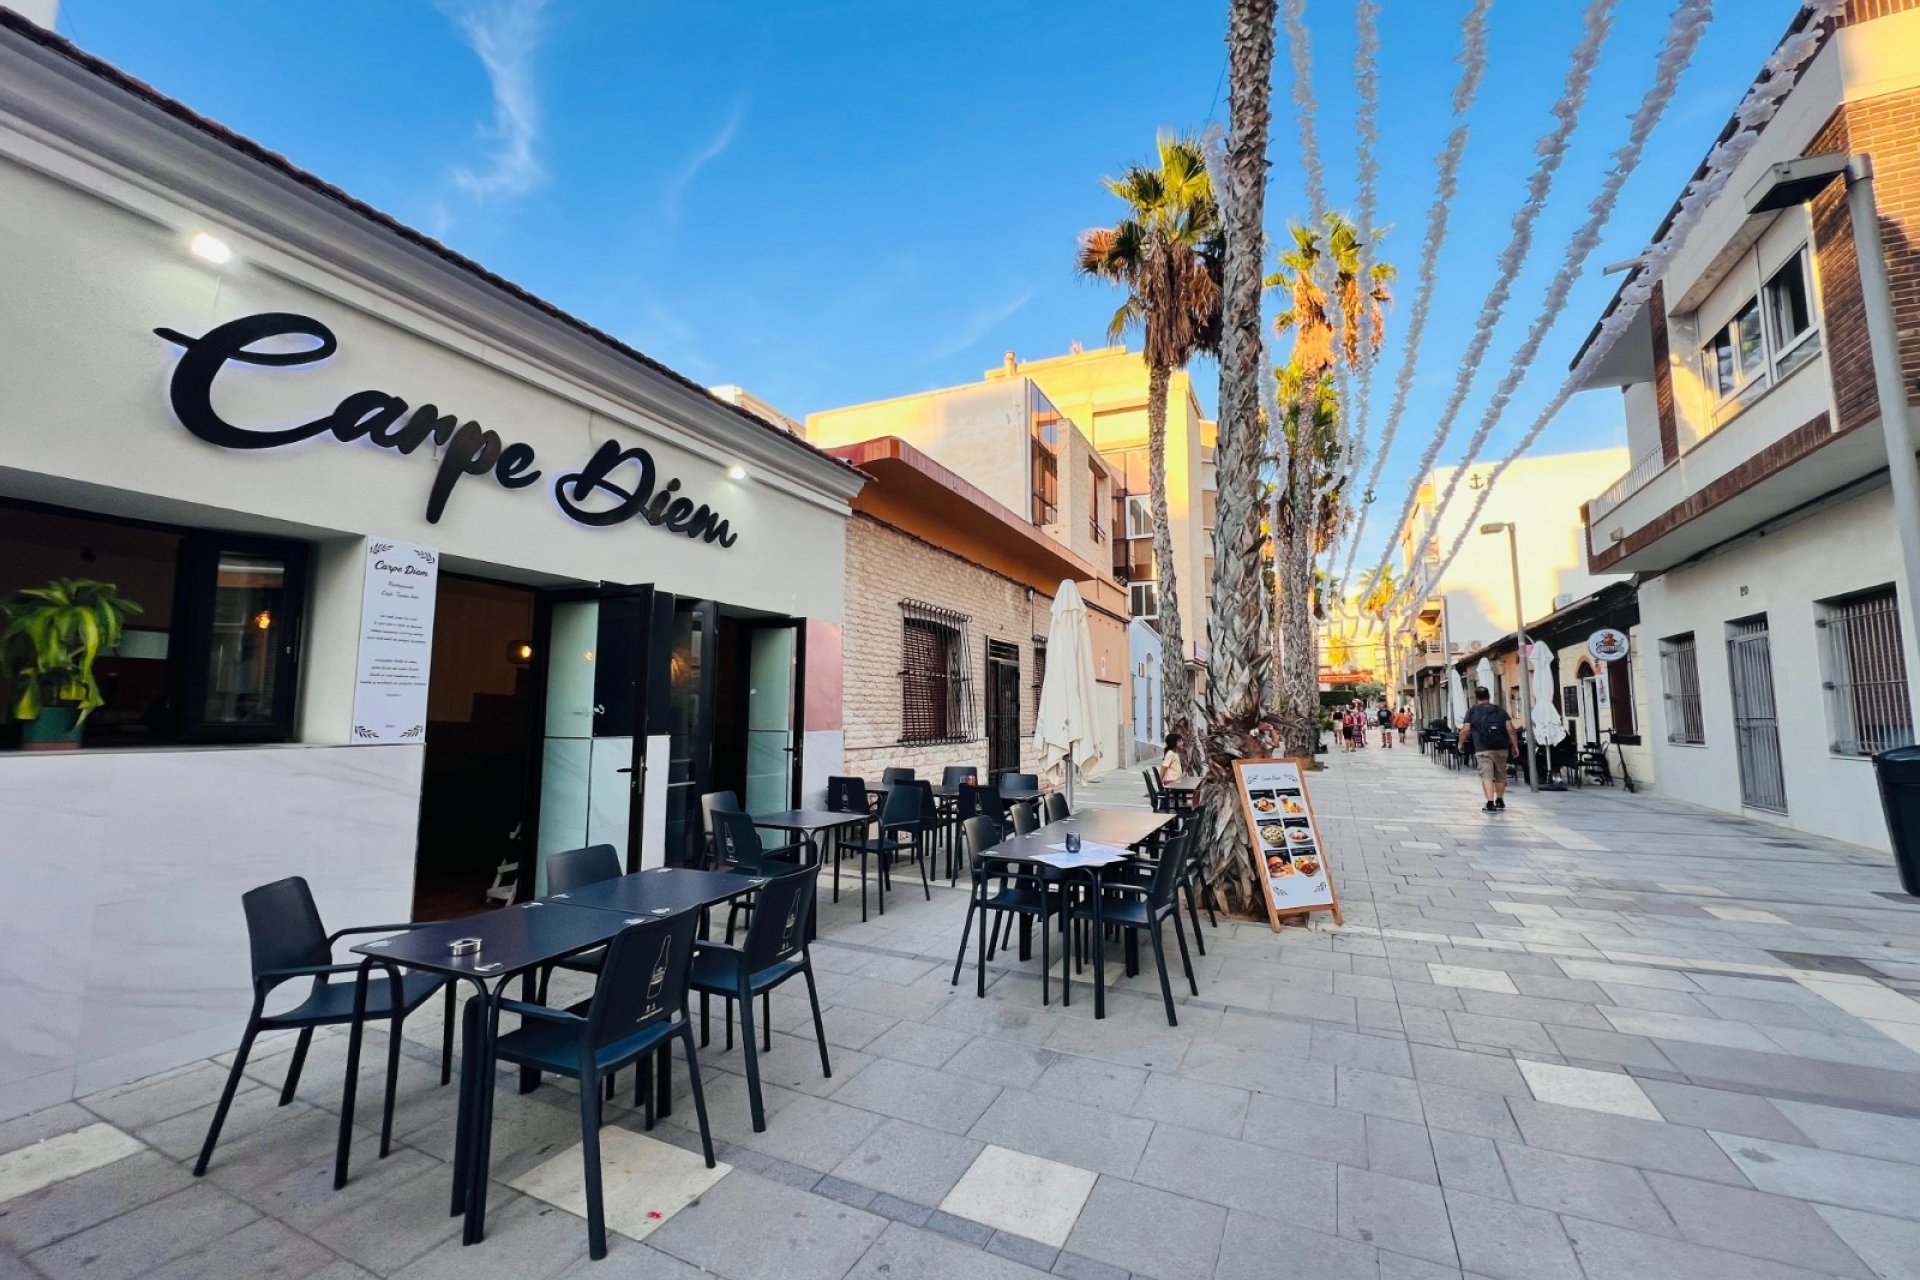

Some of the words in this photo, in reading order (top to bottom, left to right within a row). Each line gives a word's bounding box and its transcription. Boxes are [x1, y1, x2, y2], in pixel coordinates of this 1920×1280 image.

[153, 312, 542, 524] Carpe
[555, 439, 738, 548] Diem
[374, 560, 402, 573] Carpe
[404, 565, 428, 576] Diem
